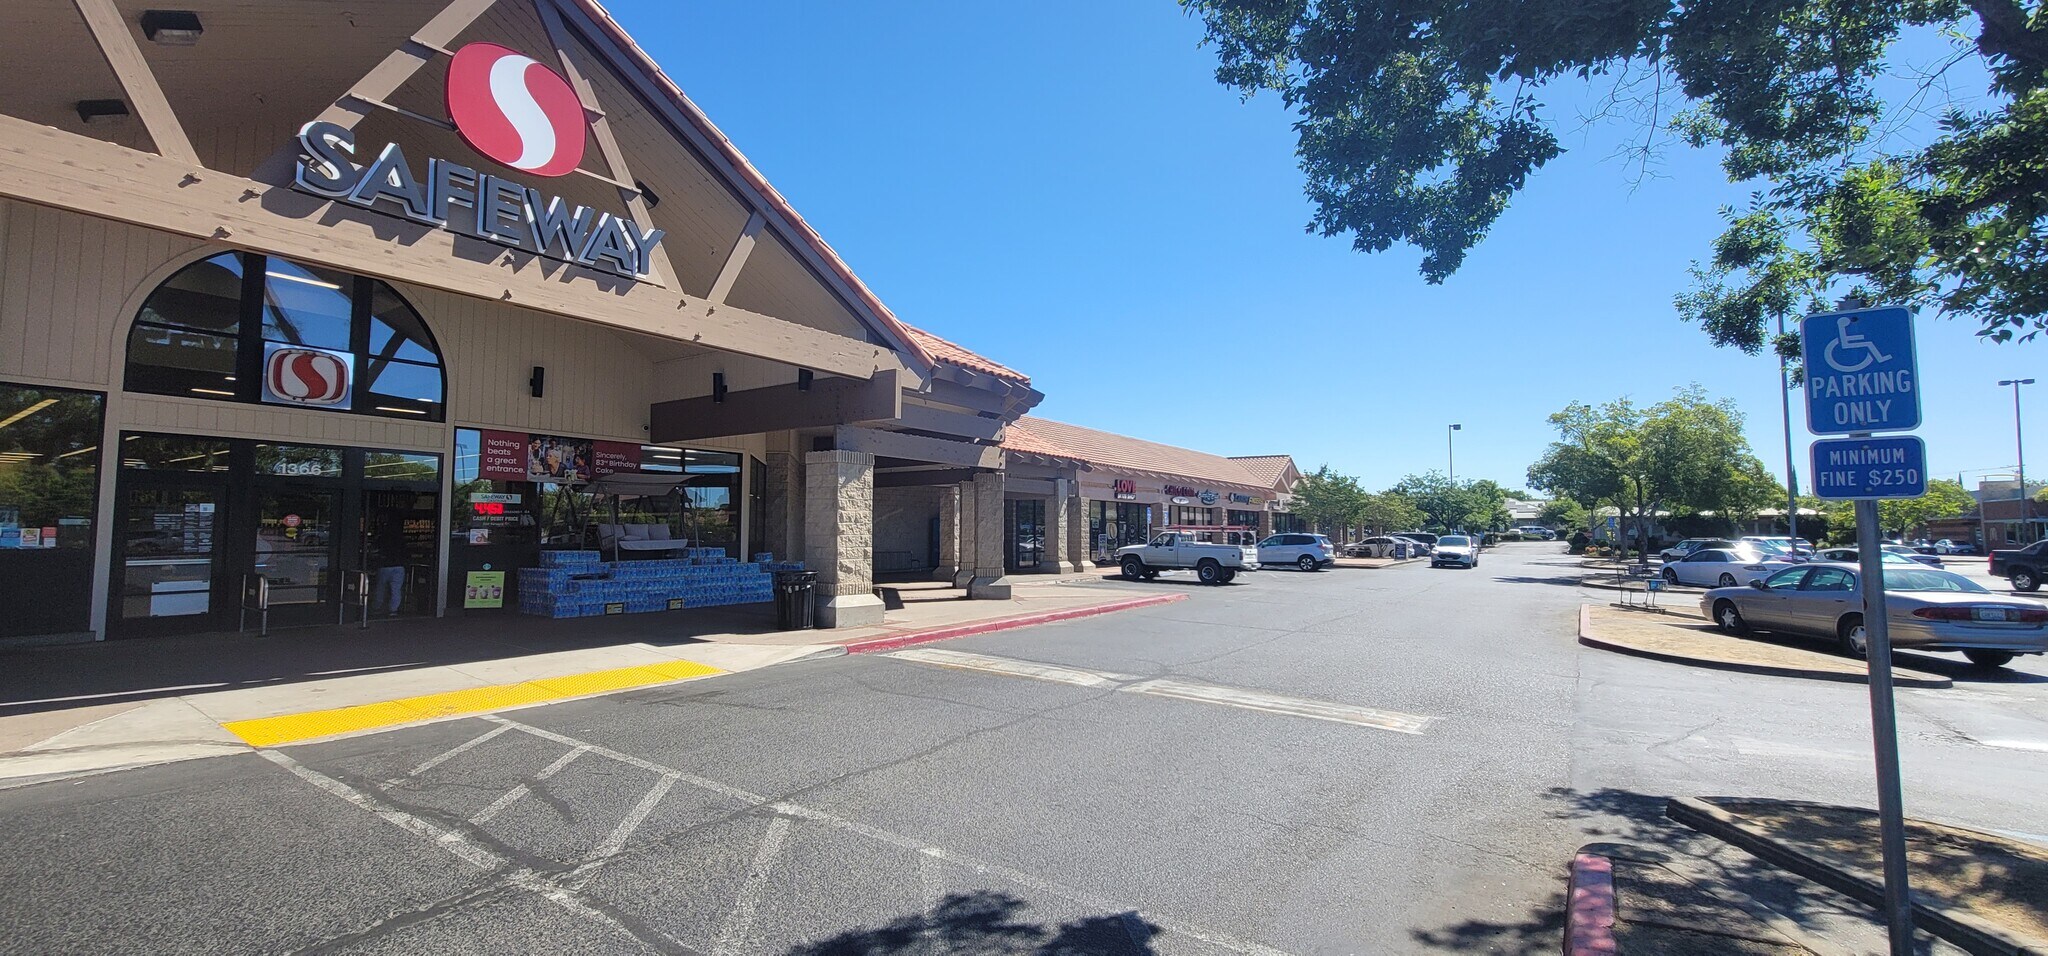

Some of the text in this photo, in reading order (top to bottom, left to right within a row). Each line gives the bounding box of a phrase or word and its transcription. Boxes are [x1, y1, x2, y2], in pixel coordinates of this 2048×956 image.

[295, 119, 666, 279] SAFEWAY
[1811, 369, 1912, 399] PARKING
[1834, 399, 1892, 425] ONLY
[487, 438, 520, 450] Nothing
[487, 447, 512, 456] beats
[595, 451, 627, 462] Sincerely,
[1829, 447, 1905, 466] MINIMUM
[494, 457, 517, 467] great
[609, 460, 638, 470] Birthday
[280, 462, 322, 476] 1366
[486, 465, 526, 474] entrance.
[1820, 468, 1918, 488] FINE $250
